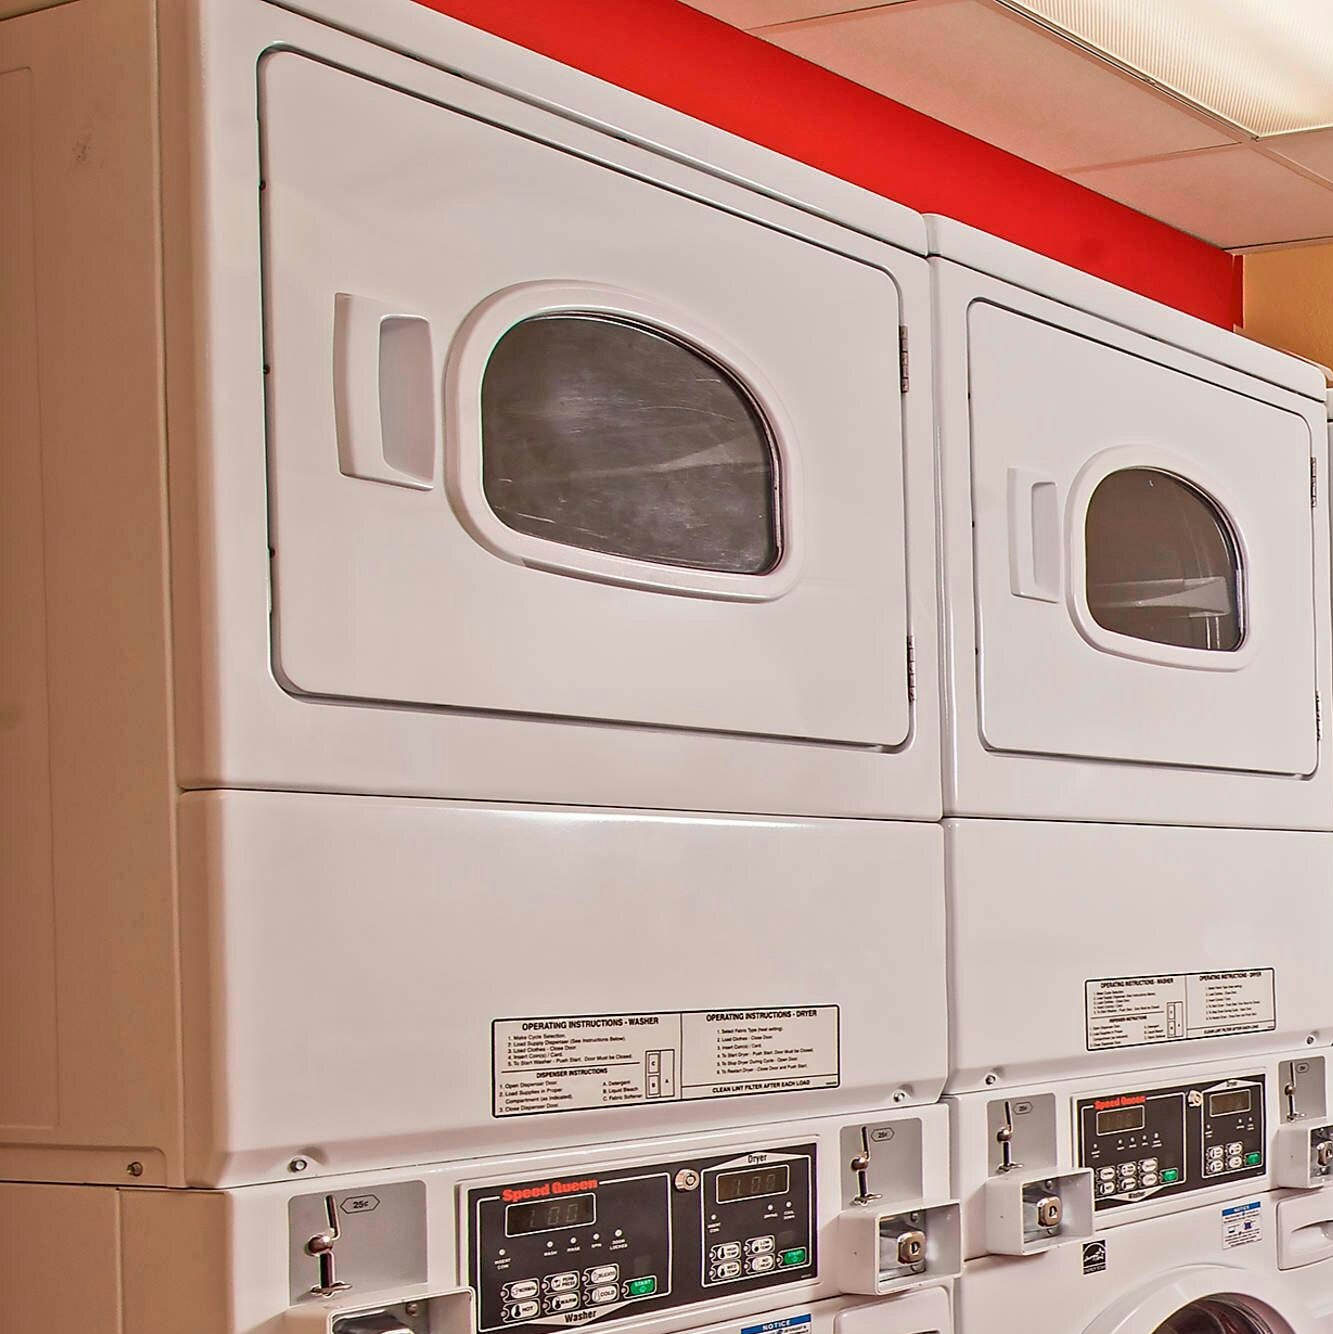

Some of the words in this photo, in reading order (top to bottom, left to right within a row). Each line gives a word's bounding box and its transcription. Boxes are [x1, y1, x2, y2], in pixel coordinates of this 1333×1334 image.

[706, 1013, 743, 1022] OPERATING
[745, 1010, 792, 1020] INSTRUCTIONS
[522, 1021, 567, 1031] OPERATING
[568, 1018, 623, 1029] INSTRUCTIONS
[628, 1016, 659, 1026] WASHER
[712, 1086, 731, 1094] CLEAN
[747, 1154, 768, 1165] Dryer
[502, 1184, 550, 1203] Speed
[551, 1179, 598, 1194] Queen
[564, 1309, 597, 1323] Washer
[762, 1319, 791, 1331] NOTICE
